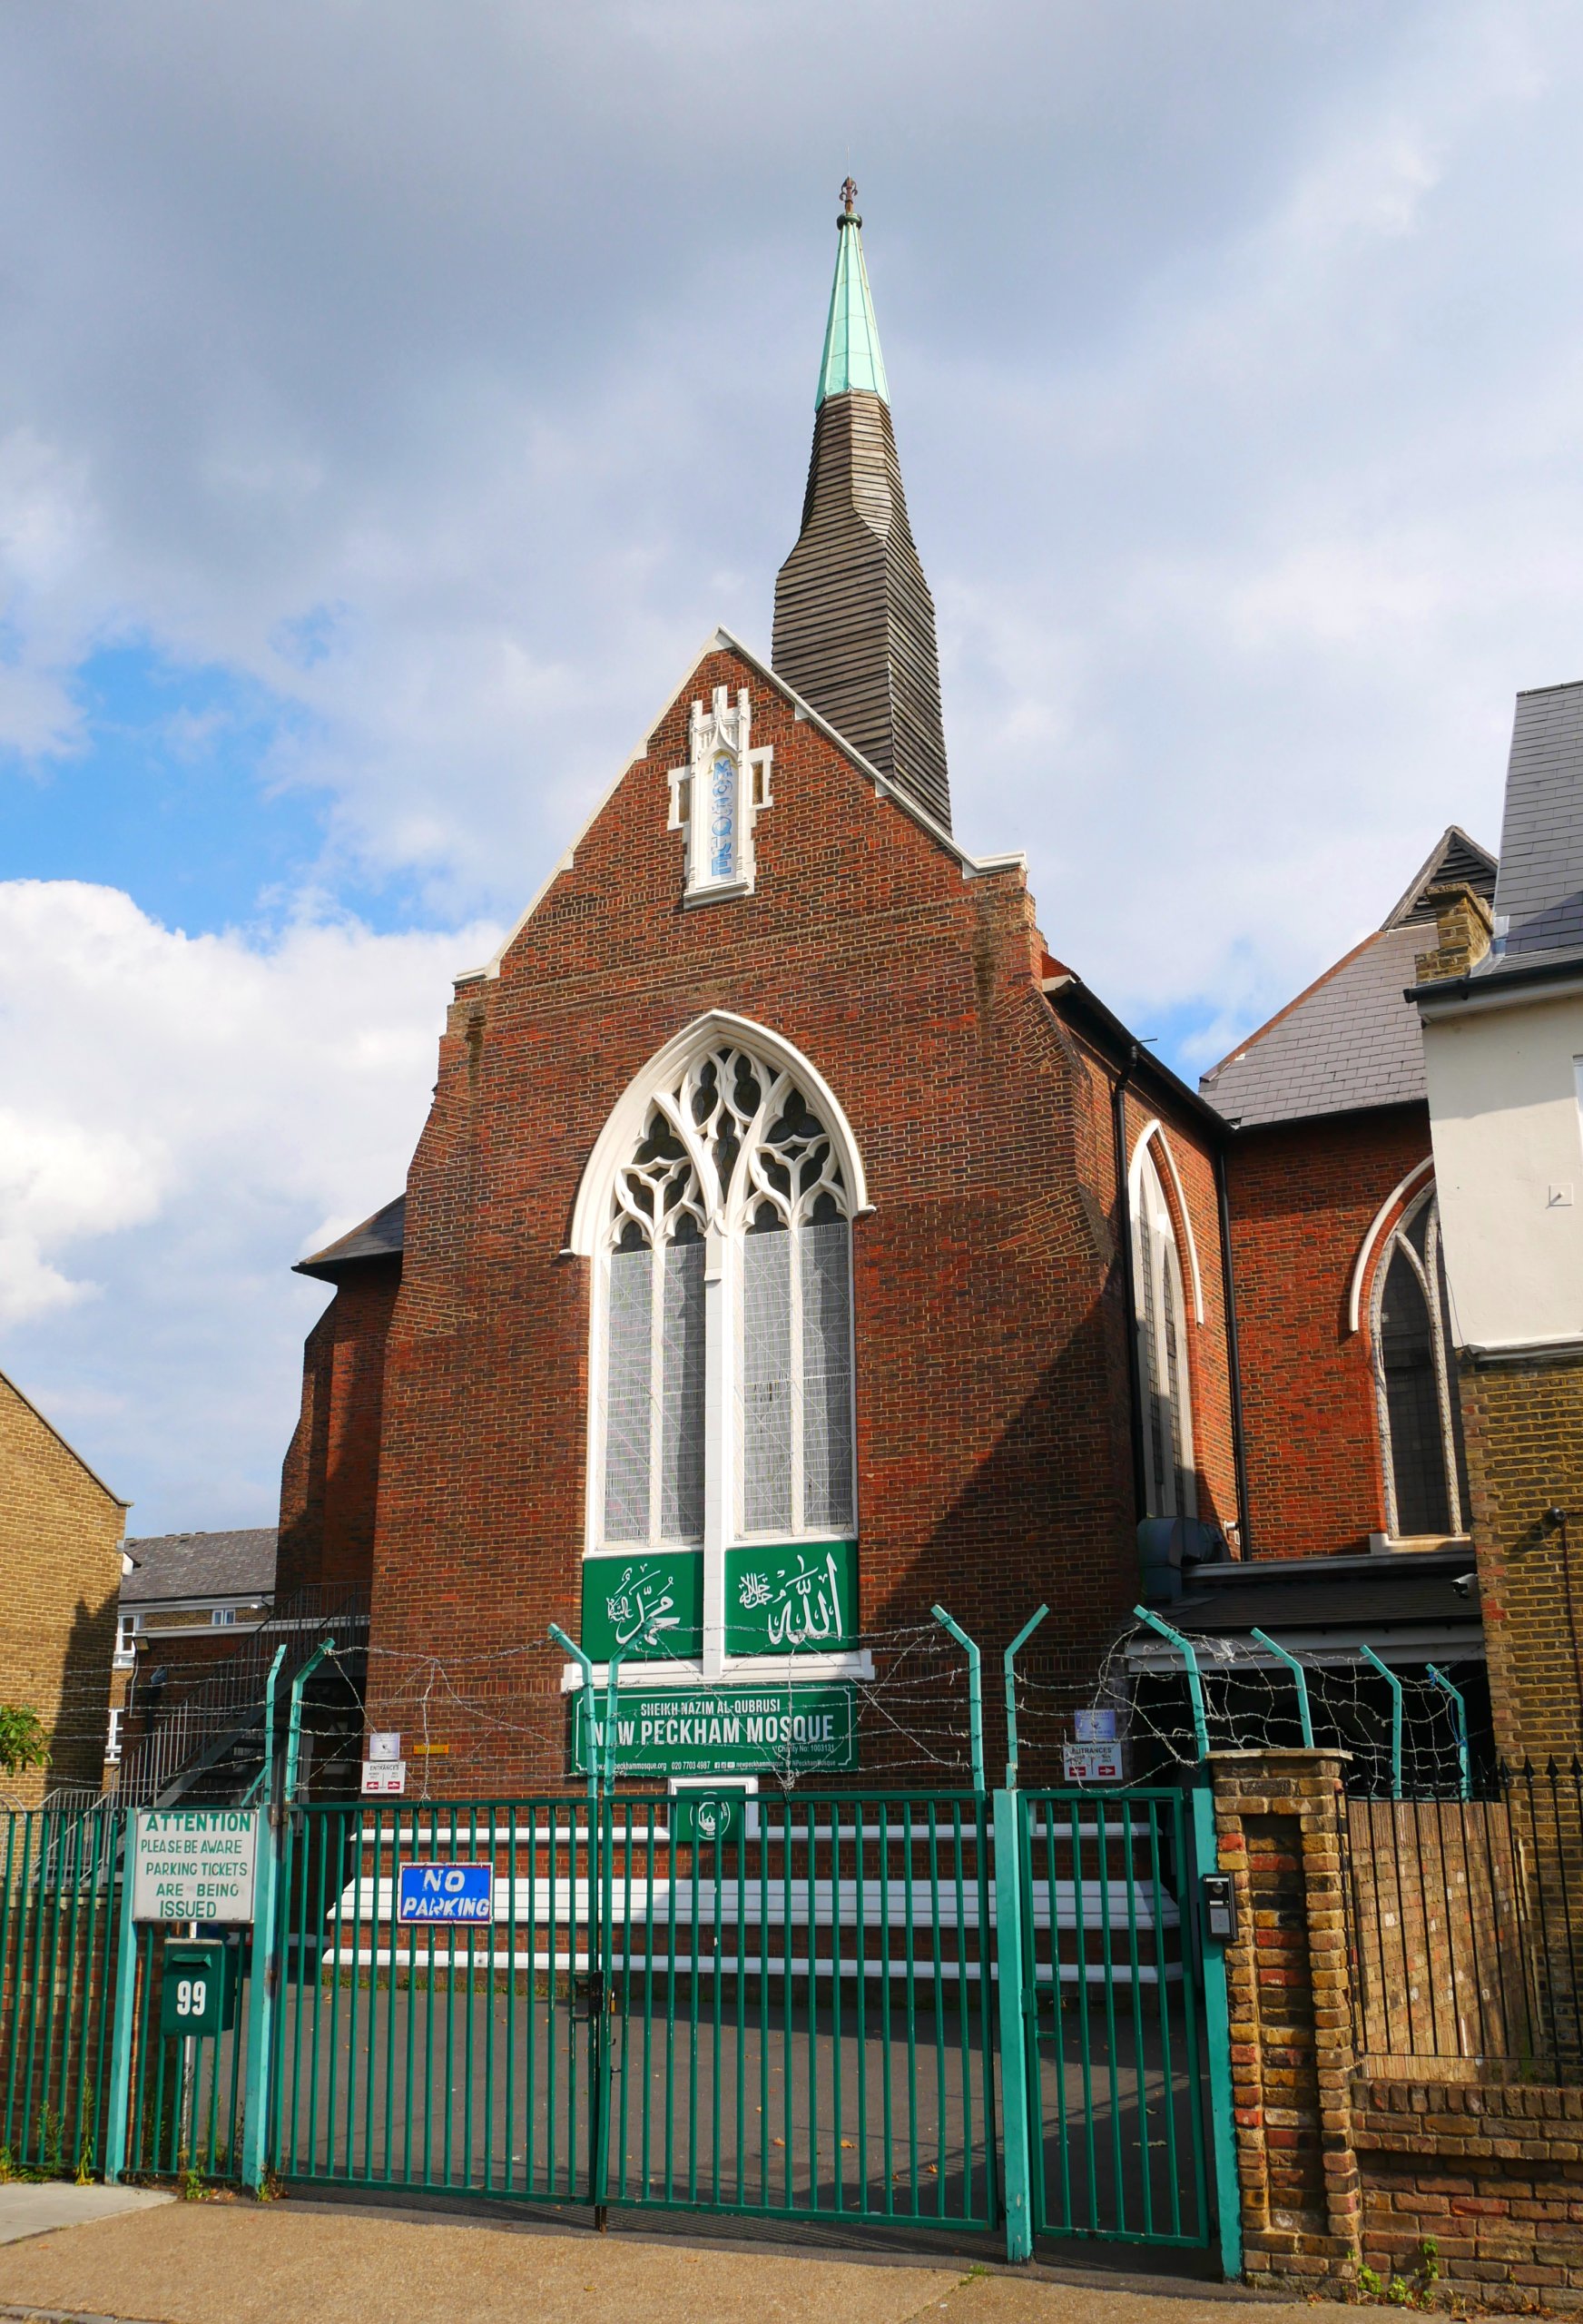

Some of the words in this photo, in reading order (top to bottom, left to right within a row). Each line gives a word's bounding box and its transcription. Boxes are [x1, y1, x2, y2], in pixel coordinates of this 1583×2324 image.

[712, 759, 733, 877] MOSQUE
[641, 1702, 678, 1717] SHEIKH
[681, 1700, 714, 1716] NAZIM
[717, 1699, 781, 1714] AL-QUBRUSI
[595, 1719, 635, 1747] NW
[641, 1716, 740, 1746] PECKHAM
[746, 1714, 834, 1743] MOSQUE
[672, 1761, 682, 1770] 020
[683, 1761, 696, 1770] 7703
[145, 1813, 251, 1832] ATTENTION
[141, 1838, 182, 1854] PLEASE
[183, 1839, 199, 1854] BE
[200, 1839, 243, 1854] AWARE
[145, 1861, 198, 1876] PARKING
[201, 1861, 248, 1876] TICKETS
[155, 1882, 184, 1896] ARE
[196, 1882, 239, 1897] BEING
[422, 1869, 466, 1893] NO
[159, 1900, 217, 1918] ISSUED
[402, 1896, 490, 1917] PARKING
[176, 1980, 207, 2016] 99
